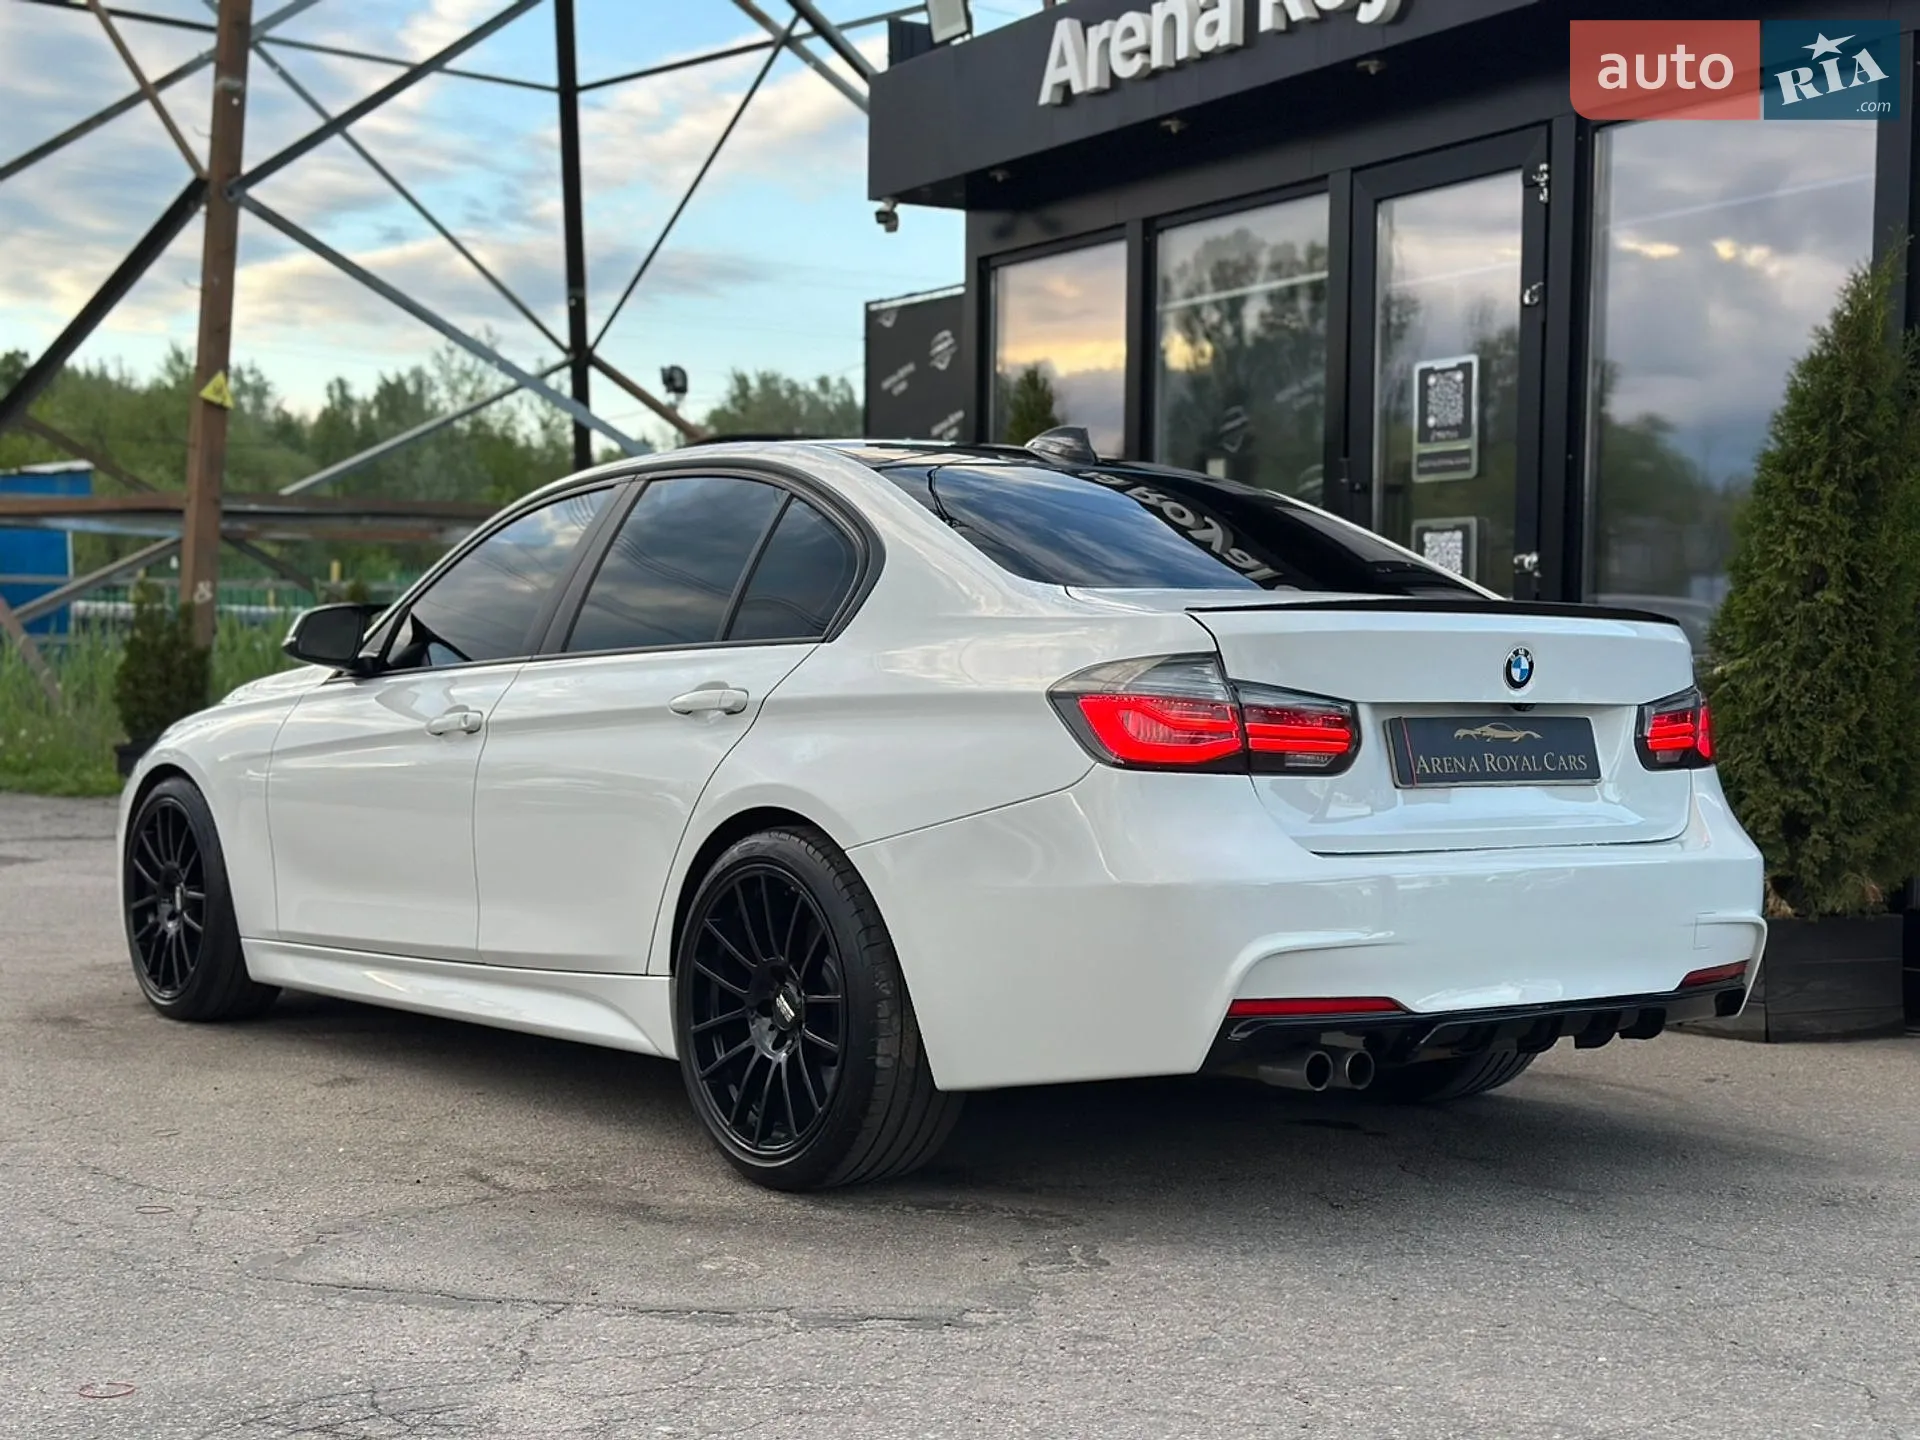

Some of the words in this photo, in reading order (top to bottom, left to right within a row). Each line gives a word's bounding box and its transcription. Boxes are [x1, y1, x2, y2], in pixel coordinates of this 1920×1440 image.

[1038, 0, 1243, 106] Arena
[1416, 755, 1480, 774] ARENA
[1484, 753, 1542, 773] ROYAL
[1544, 752, 1588, 771] CARS
